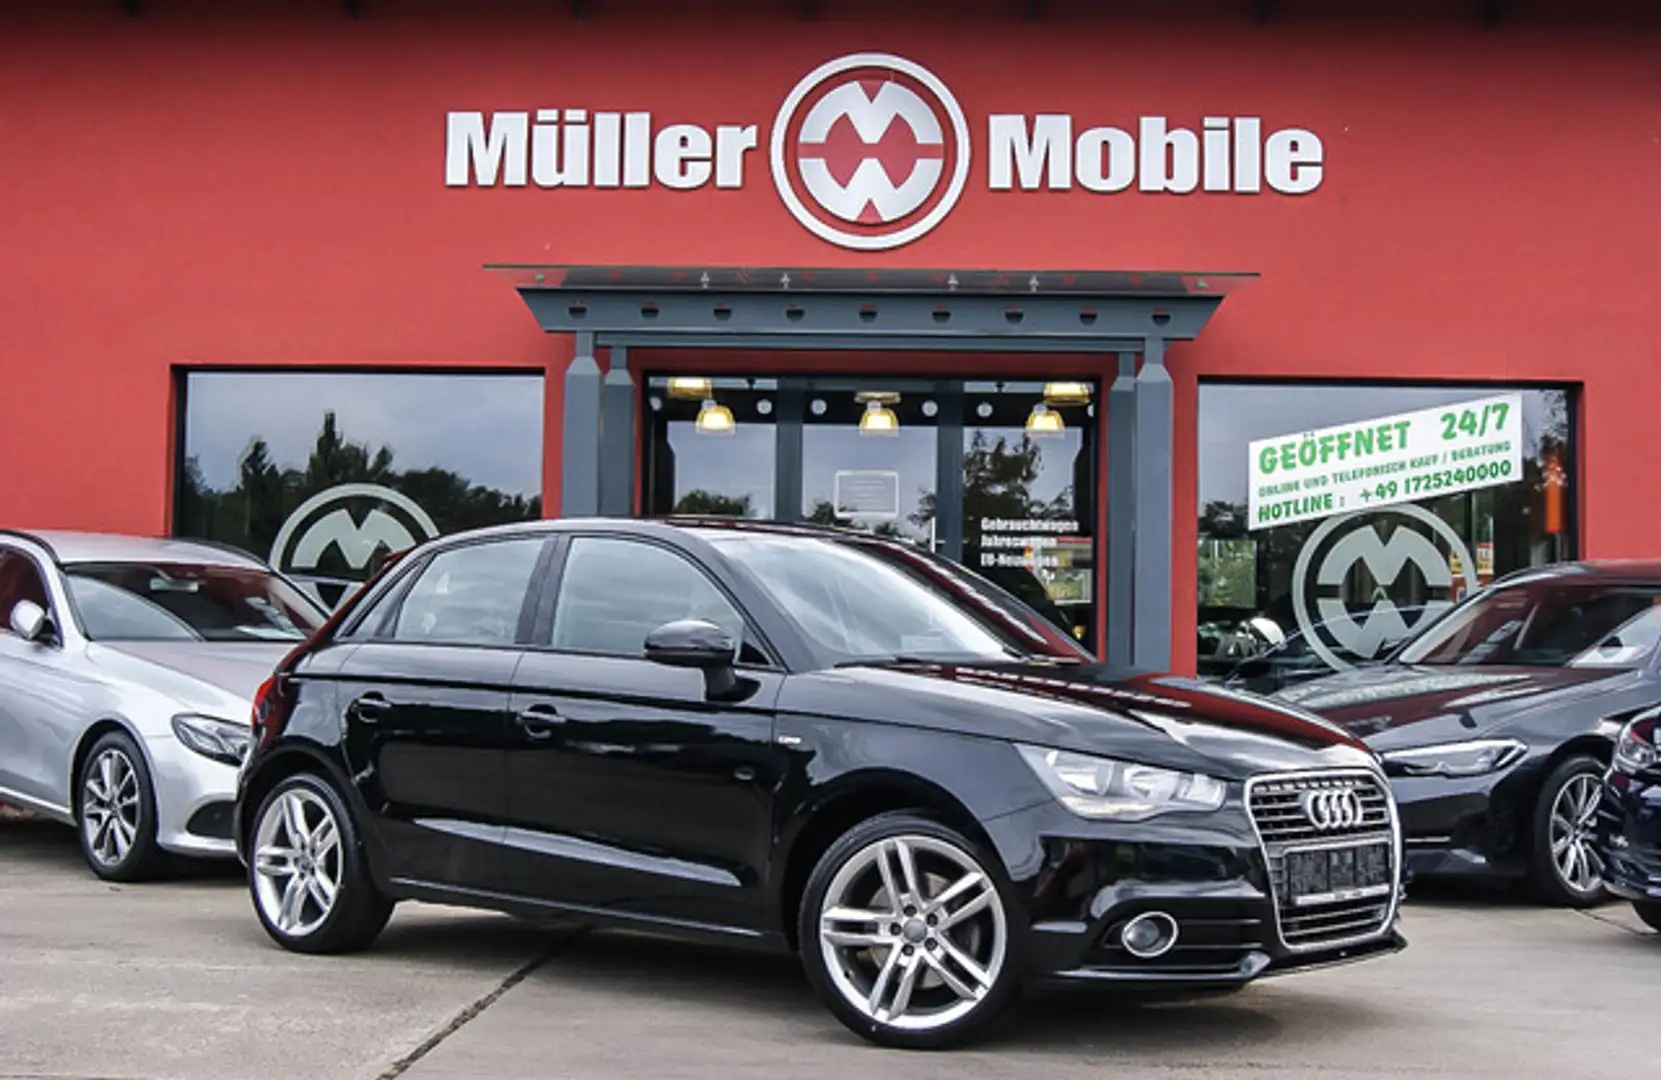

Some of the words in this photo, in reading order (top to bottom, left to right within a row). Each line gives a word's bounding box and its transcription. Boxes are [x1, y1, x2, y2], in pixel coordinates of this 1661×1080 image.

[445, 109, 757, 189] Müller
[988, 114, 1323, 194] Mobile
[1258, 421, 1411, 474] GEÖFFNET
[1440, 403, 1510, 440] 24/7
[1258, 480, 1300, 497] ONLINE
[1303, 475, 1328, 489] UND
[1332, 462, 1407, 484] TELEFONISCH
[1410, 455, 1438, 470] KAUF
[1451, 441, 1512, 462] BERATUNG
[1258, 493, 1333, 522] HOTLINE
[1404, 460, 1512, 494] 1725240000
